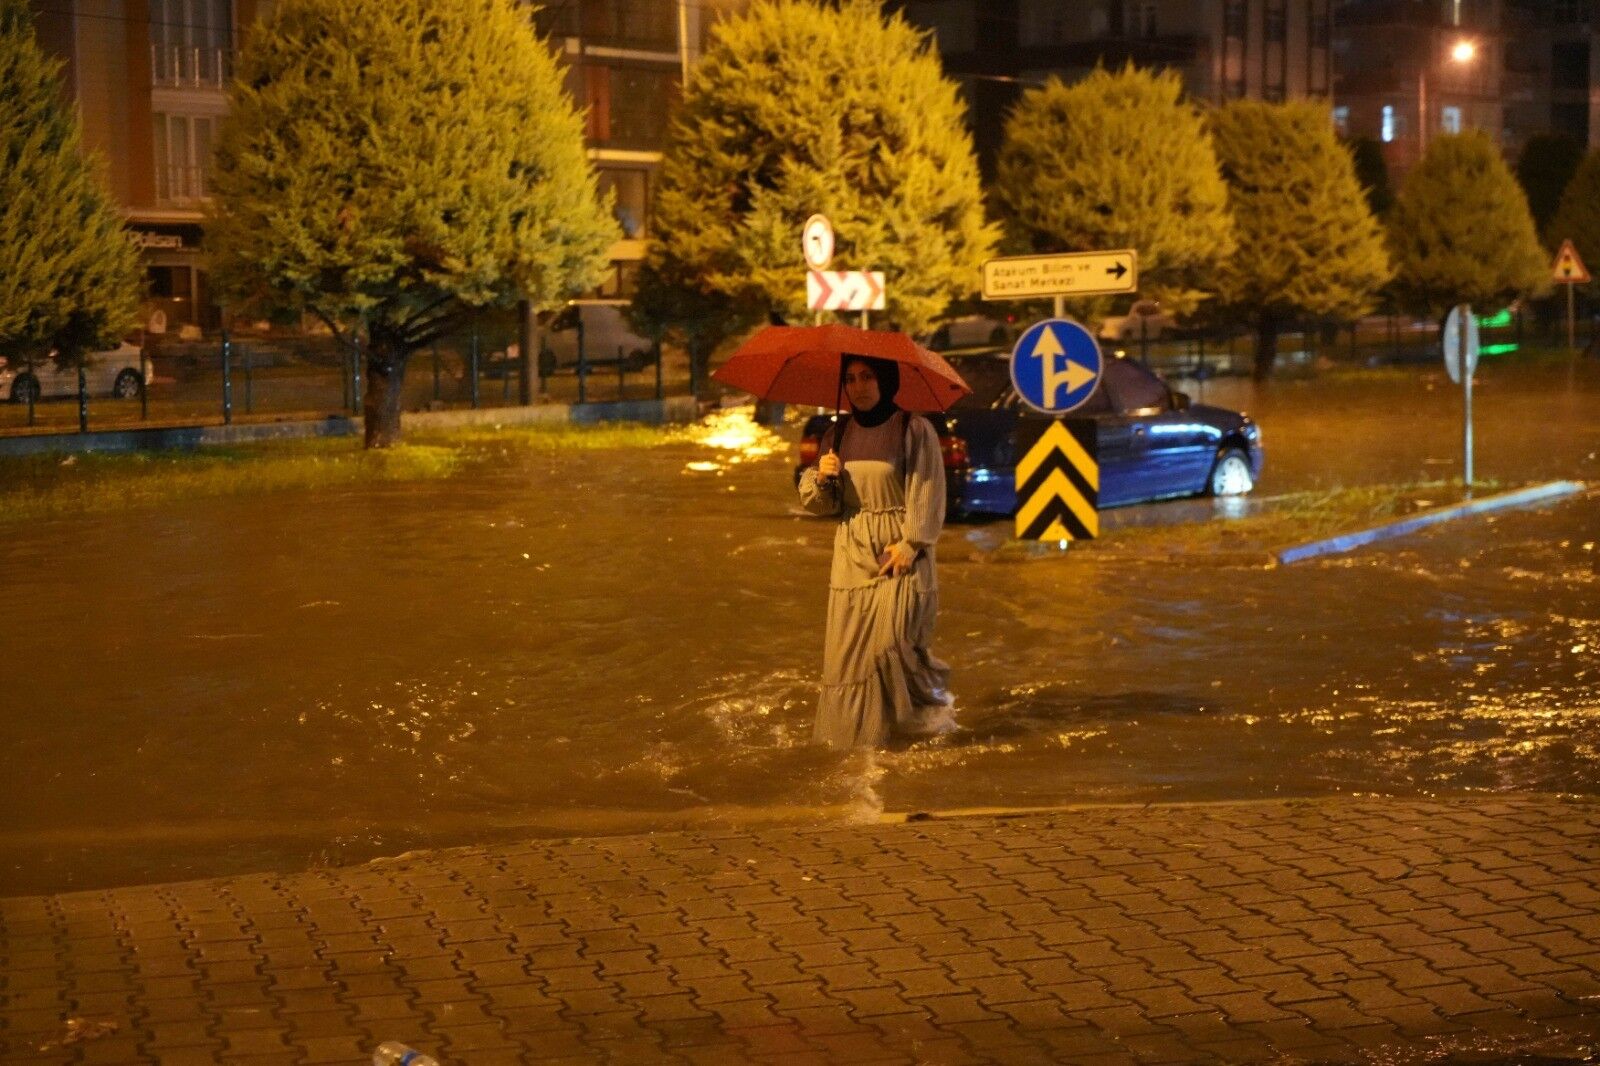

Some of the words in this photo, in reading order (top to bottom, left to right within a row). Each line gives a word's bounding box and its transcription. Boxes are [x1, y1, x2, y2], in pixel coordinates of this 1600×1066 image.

[993, 267, 1037, 277] Atakum
[992, 280, 1026, 290] Sanat
[1030, 277, 1075, 287] Merkezi
